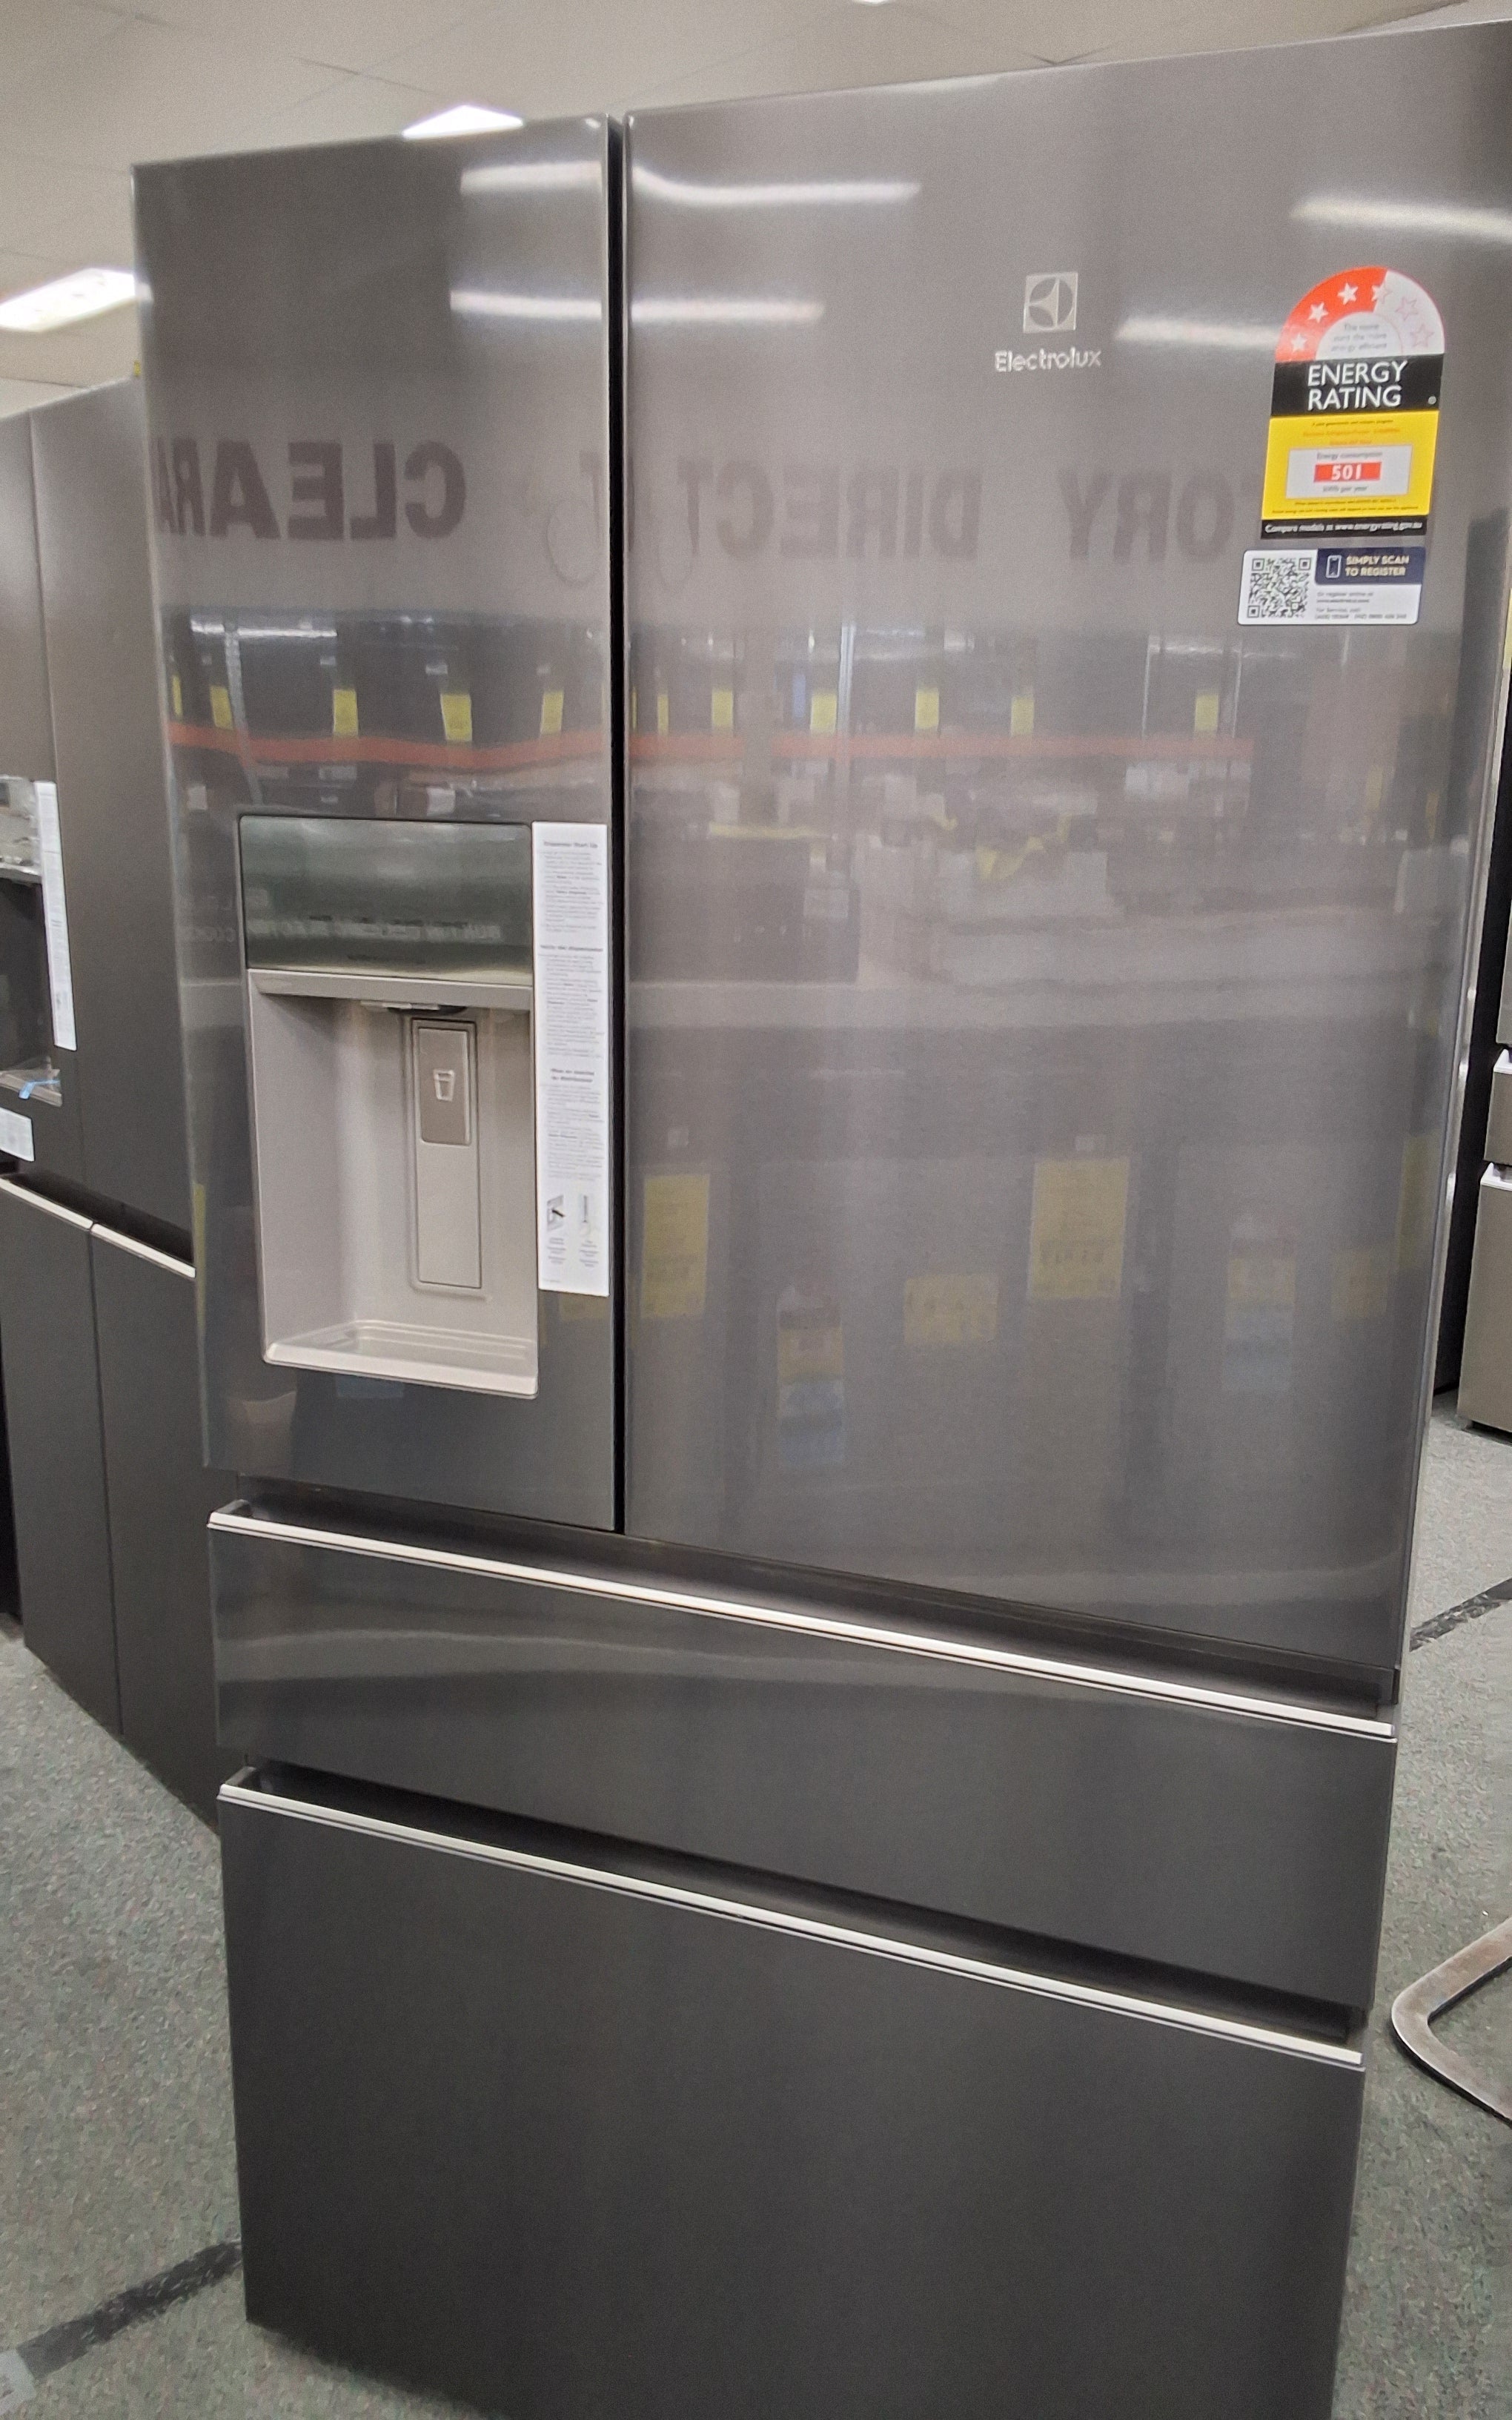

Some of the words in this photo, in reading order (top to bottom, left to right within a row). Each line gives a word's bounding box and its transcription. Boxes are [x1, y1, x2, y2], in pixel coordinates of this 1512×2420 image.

[995, 346, 1101, 372] Electrolux
[1307, 360, 1408, 386] ENERGY
[1307, 385, 1402, 411] RATING
[1331, 463, 1362, 481] 501
[1264, 523, 1299, 533] Compare
[1299, 522, 1325, 532] models
[1346, 555, 1380, 565] SIMPLY
[1382, 555, 1409, 565] SCAN
[1345, 566, 1359, 576] TO
[1360, 566, 1407, 576] REGISTER
